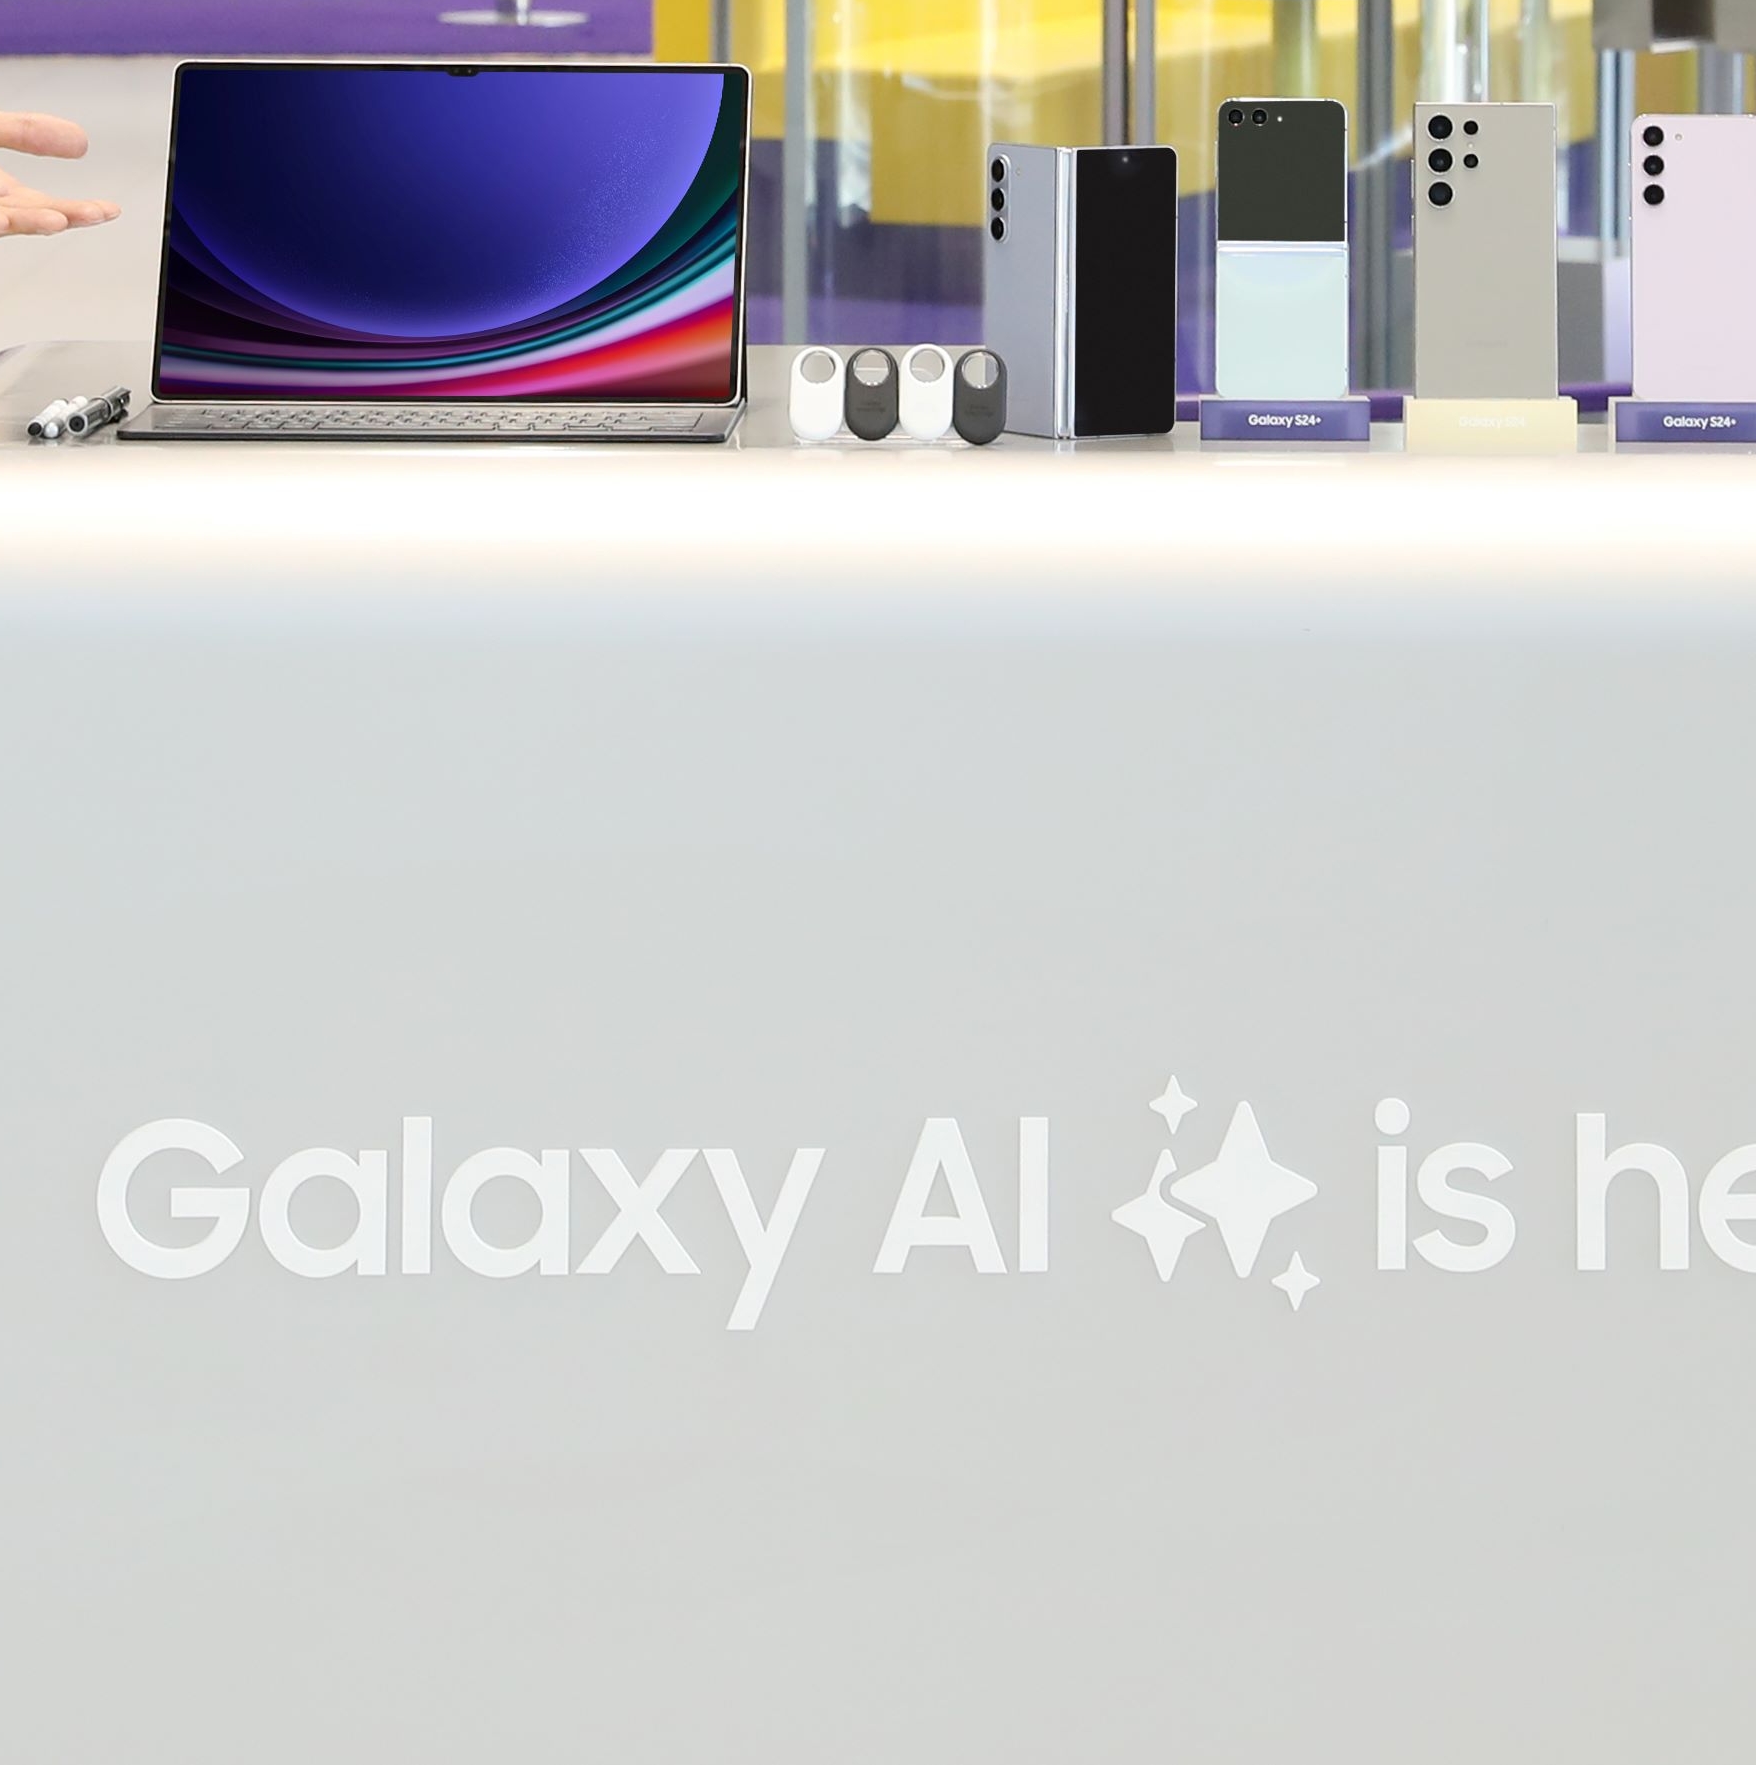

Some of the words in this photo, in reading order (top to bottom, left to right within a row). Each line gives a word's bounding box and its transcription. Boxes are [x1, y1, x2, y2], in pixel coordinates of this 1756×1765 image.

[1247, 414, 1294, 429] Galaxy
[1295, 414, 1322, 427] S24+
[1663, 415, 1709, 430] Galaxy
[1710, 416, 1737, 428] S24+
[97, 1116, 824, 1331] Galaxy
[873, 1116, 1048, 1274] AI
[1375, 1097, 1516, 1273] is
